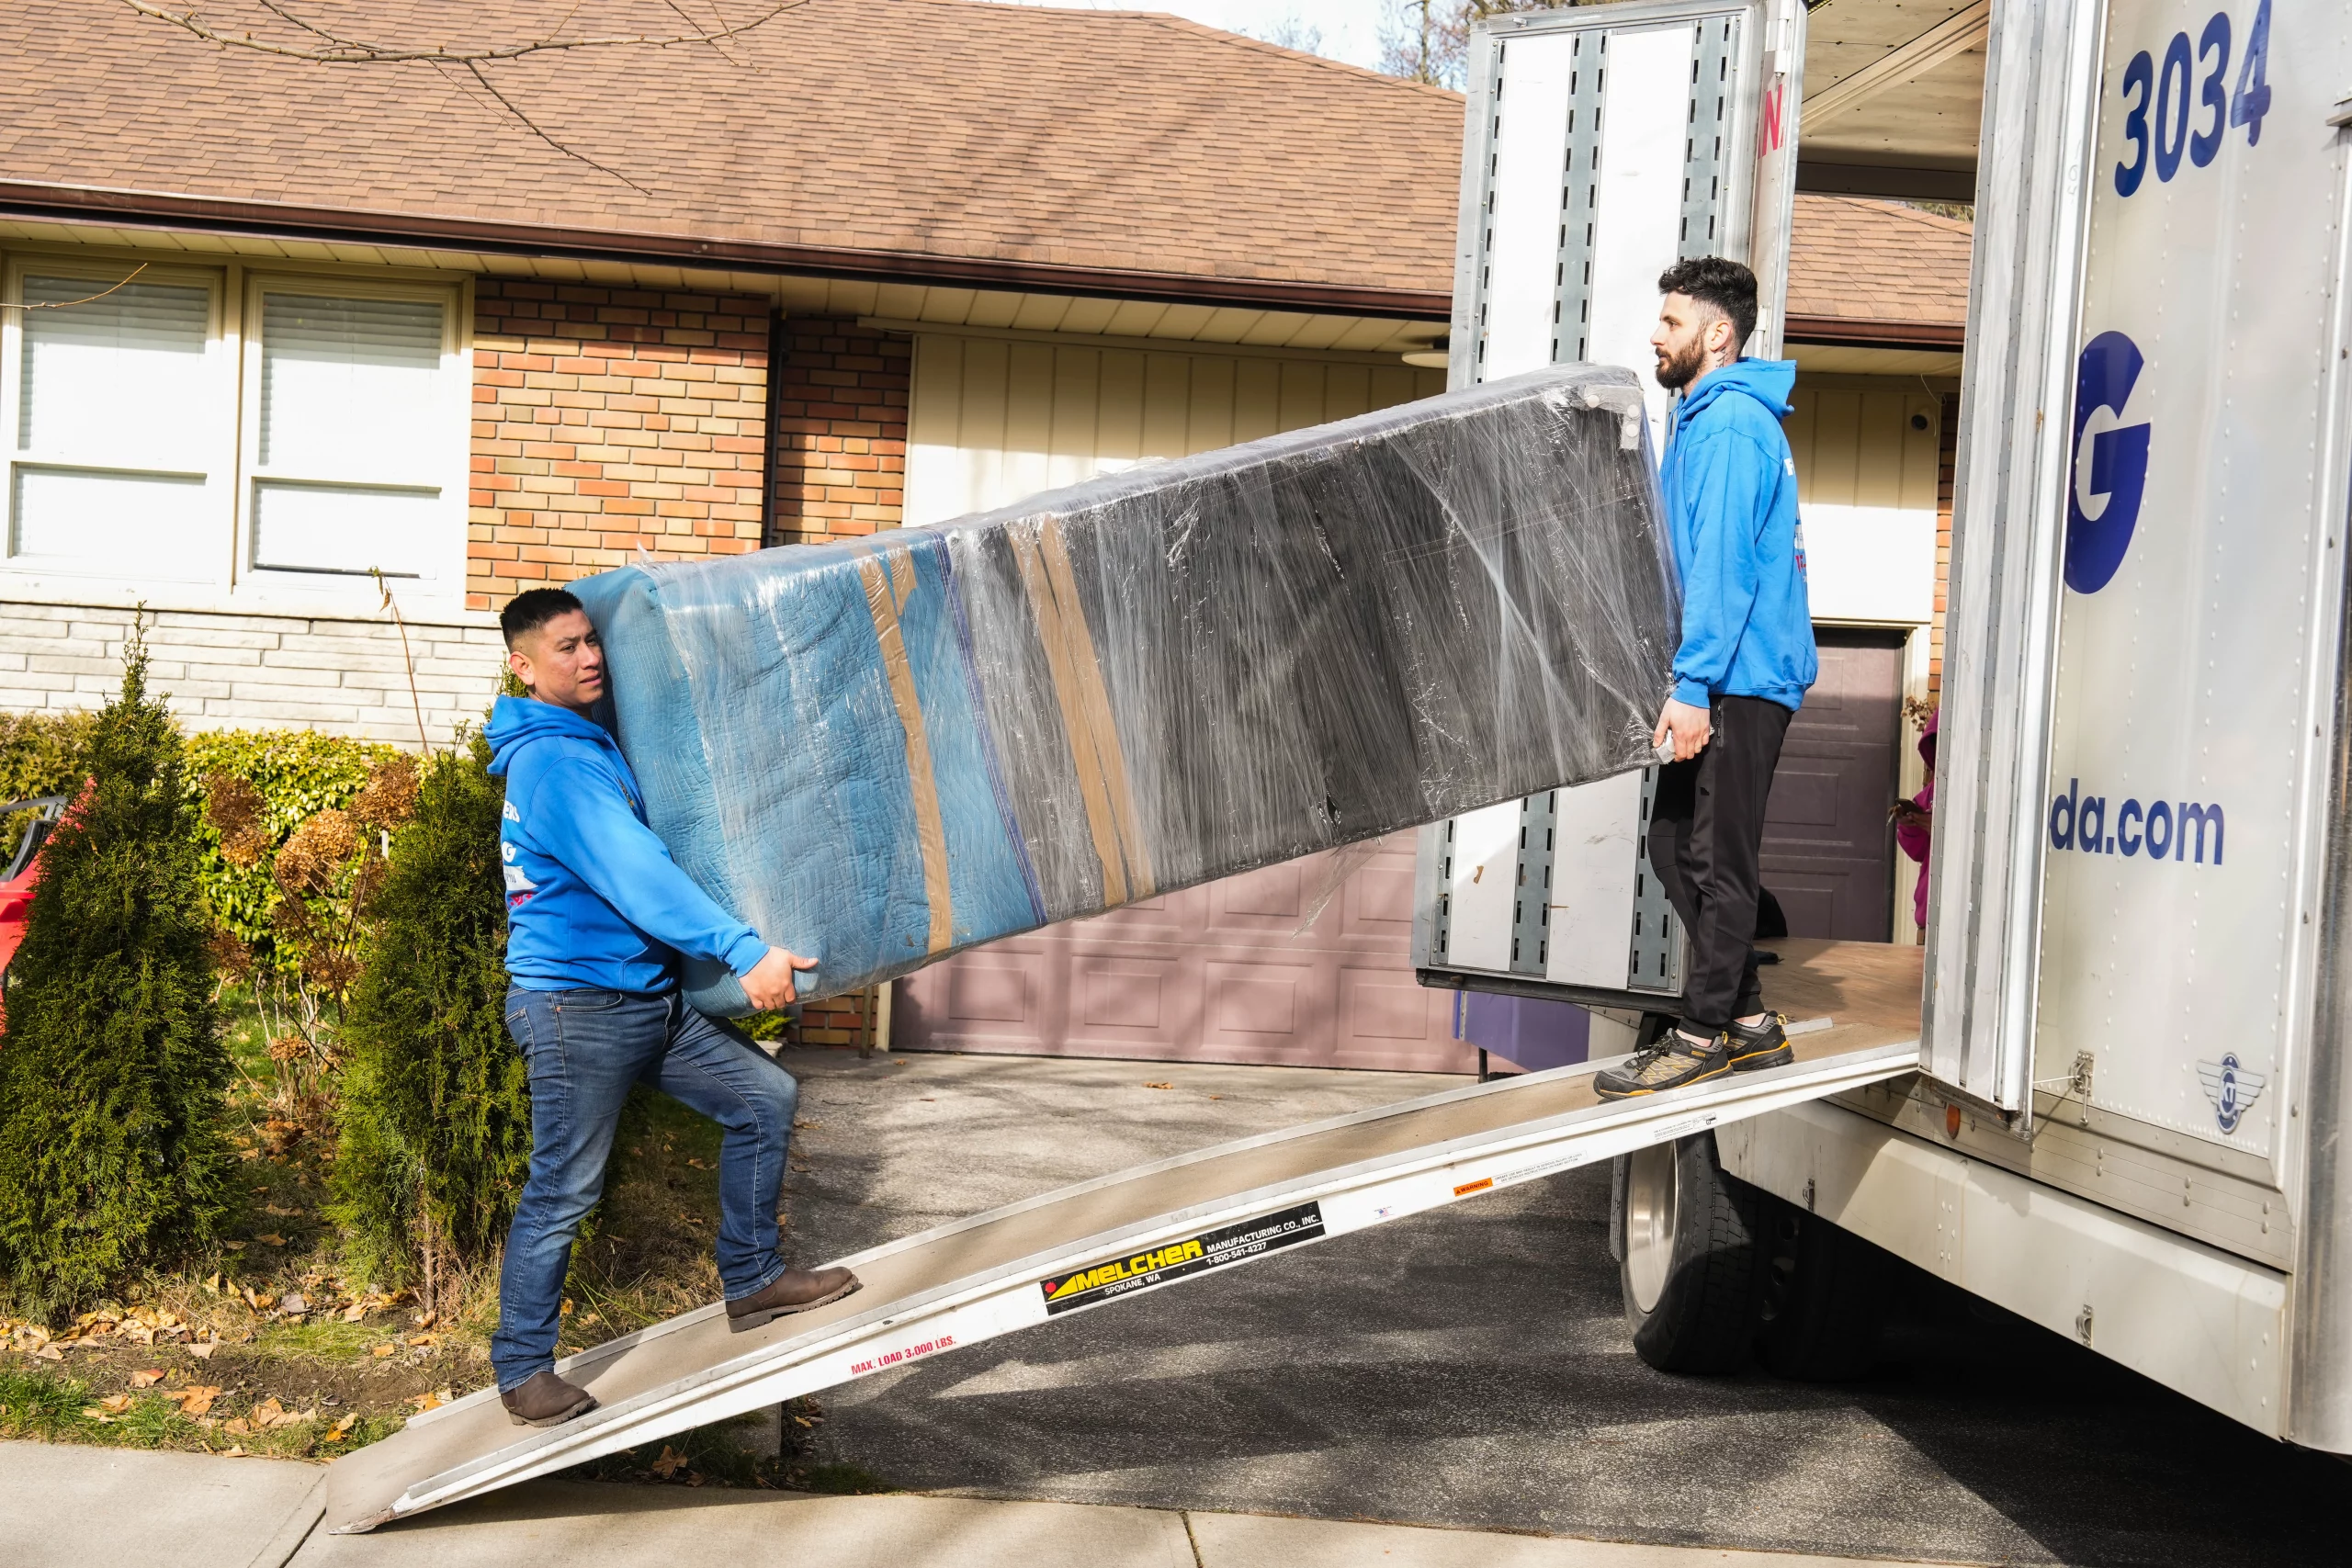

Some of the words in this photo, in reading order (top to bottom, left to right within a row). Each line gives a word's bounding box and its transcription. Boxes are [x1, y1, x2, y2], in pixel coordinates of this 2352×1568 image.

[2114, 0, 2272, 197] 3034
[2050, 777, 2224, 866] da.com
[1460, 1180, 1488, 1192] WARNING
[1206, 1224, 1282, 1254] MANUFACTURING
[1301, 1213, 1319, 1227] INC.
[1206, 1241, 1267, 1266] 1-800-541-4227
[1104, 1277, 1145, 1296] SPOKANE,
[1146, 1273, 1161, 1284] WA
[851, 1359, 876, 1375] MAX.
[878, 1351, 903, 1367] LOAD
[934, 1336, 957, 1349] LBS.
